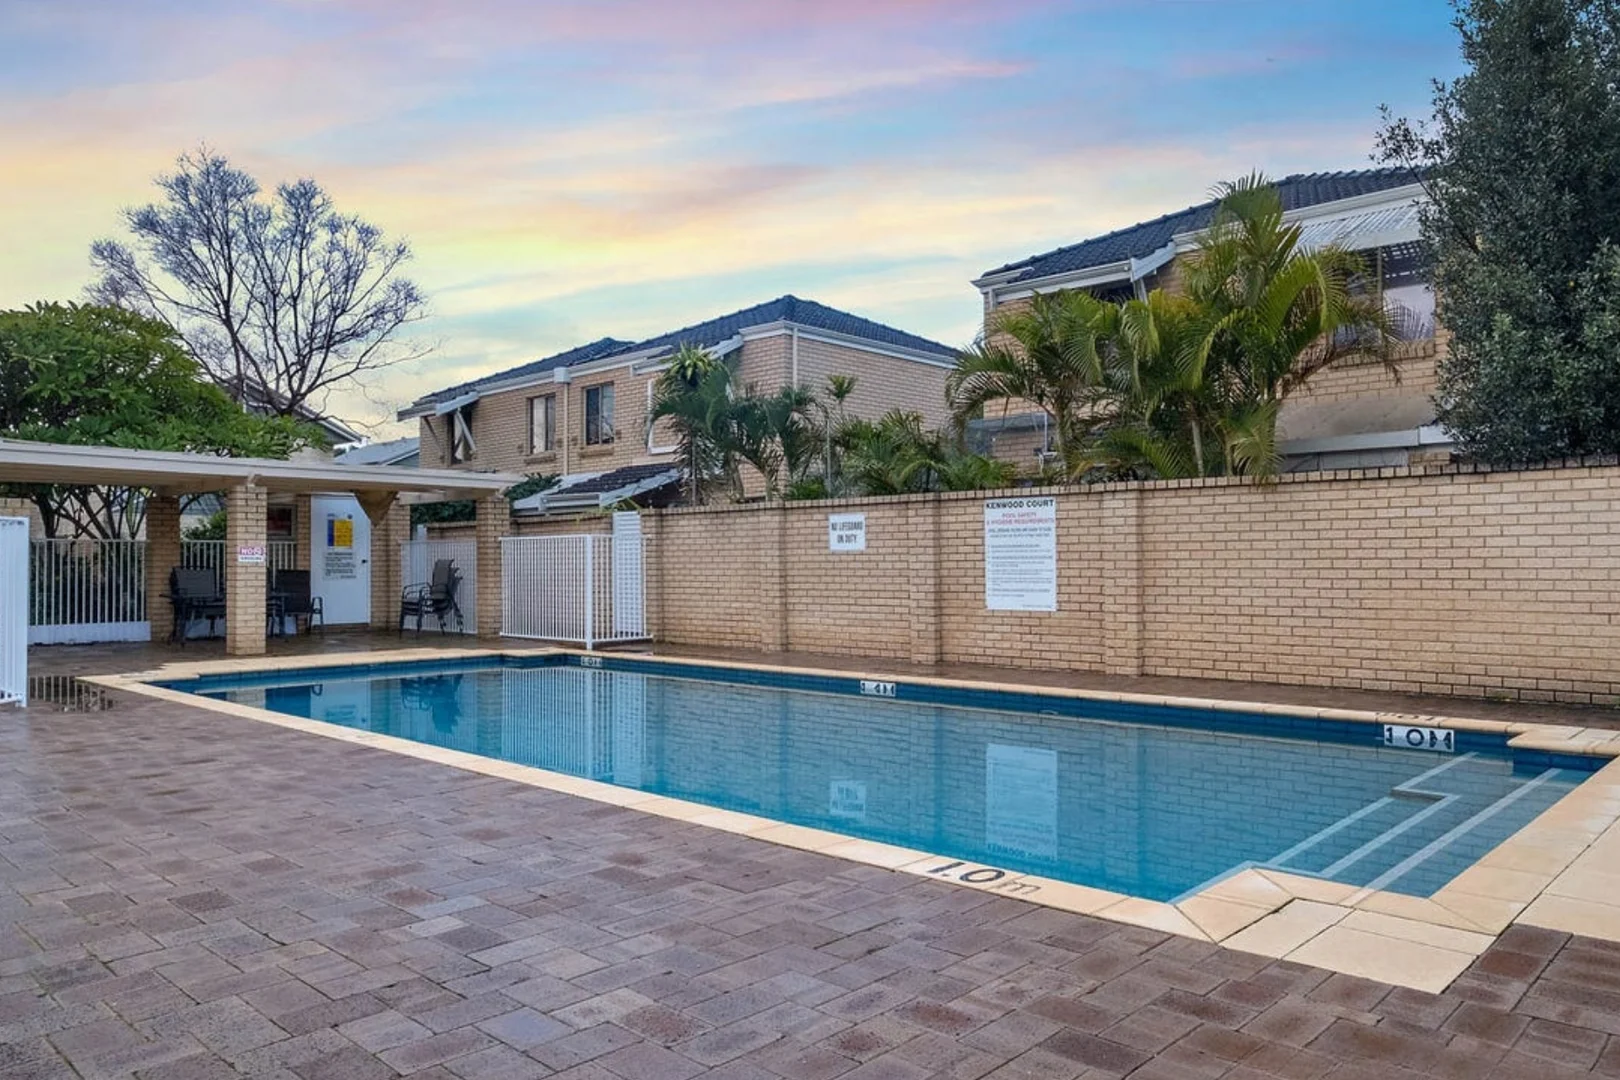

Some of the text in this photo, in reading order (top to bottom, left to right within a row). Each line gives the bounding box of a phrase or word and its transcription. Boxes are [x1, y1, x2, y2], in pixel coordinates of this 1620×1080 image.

[986, 499, 1054, 509] KENWOOD COURT
[831, 521, 863, 531] NO LIFEGUARD
[837, 534, 857, 543] ON DUTY
[926, 861, 1042, 895] 1.0m
